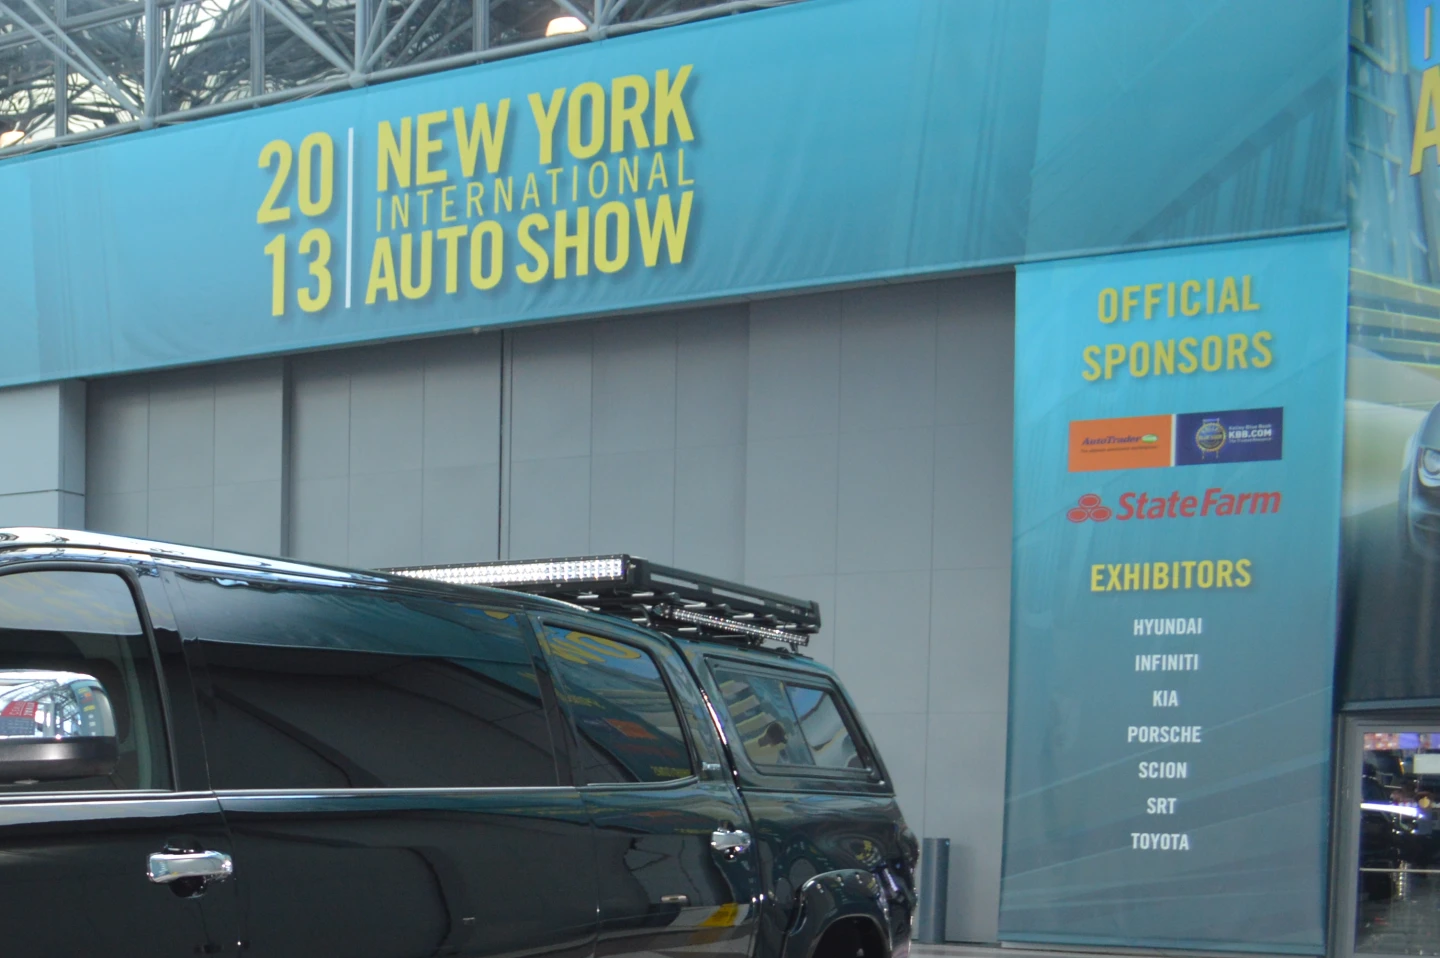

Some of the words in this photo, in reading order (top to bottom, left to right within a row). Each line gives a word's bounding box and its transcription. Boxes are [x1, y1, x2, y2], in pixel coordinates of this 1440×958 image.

[376, 98, 510, 191] NEW
[527, 64, 694, 165] YORK
[257, 131, 334, 225] 20
[376, 147, 695, 232] INTERNATIONAL
[364, 220, 504, 305] AUTO
[516, 190, 694, 284] SHOW
[263, 228, 332, 317] 13
[1098, 274, 1260, 324] OFFICIAL
[1081, 330, 1273, 381] SPONSORS
[1090, 558, 1252, 592] EXHIBITORS
[1133, 617, 1203, 636] HYUNDAI
[1135, 653, 1199, 672] INFINITI
[1152, 689, 1179, 707] KIA
[1127, 725, 1202, 743] PORSCHE
[1138, 761, 1188, 779] SCION
[1146, 797, 1177, 815] SRT
[1131, 832, 1190, 851] TOYOTA
